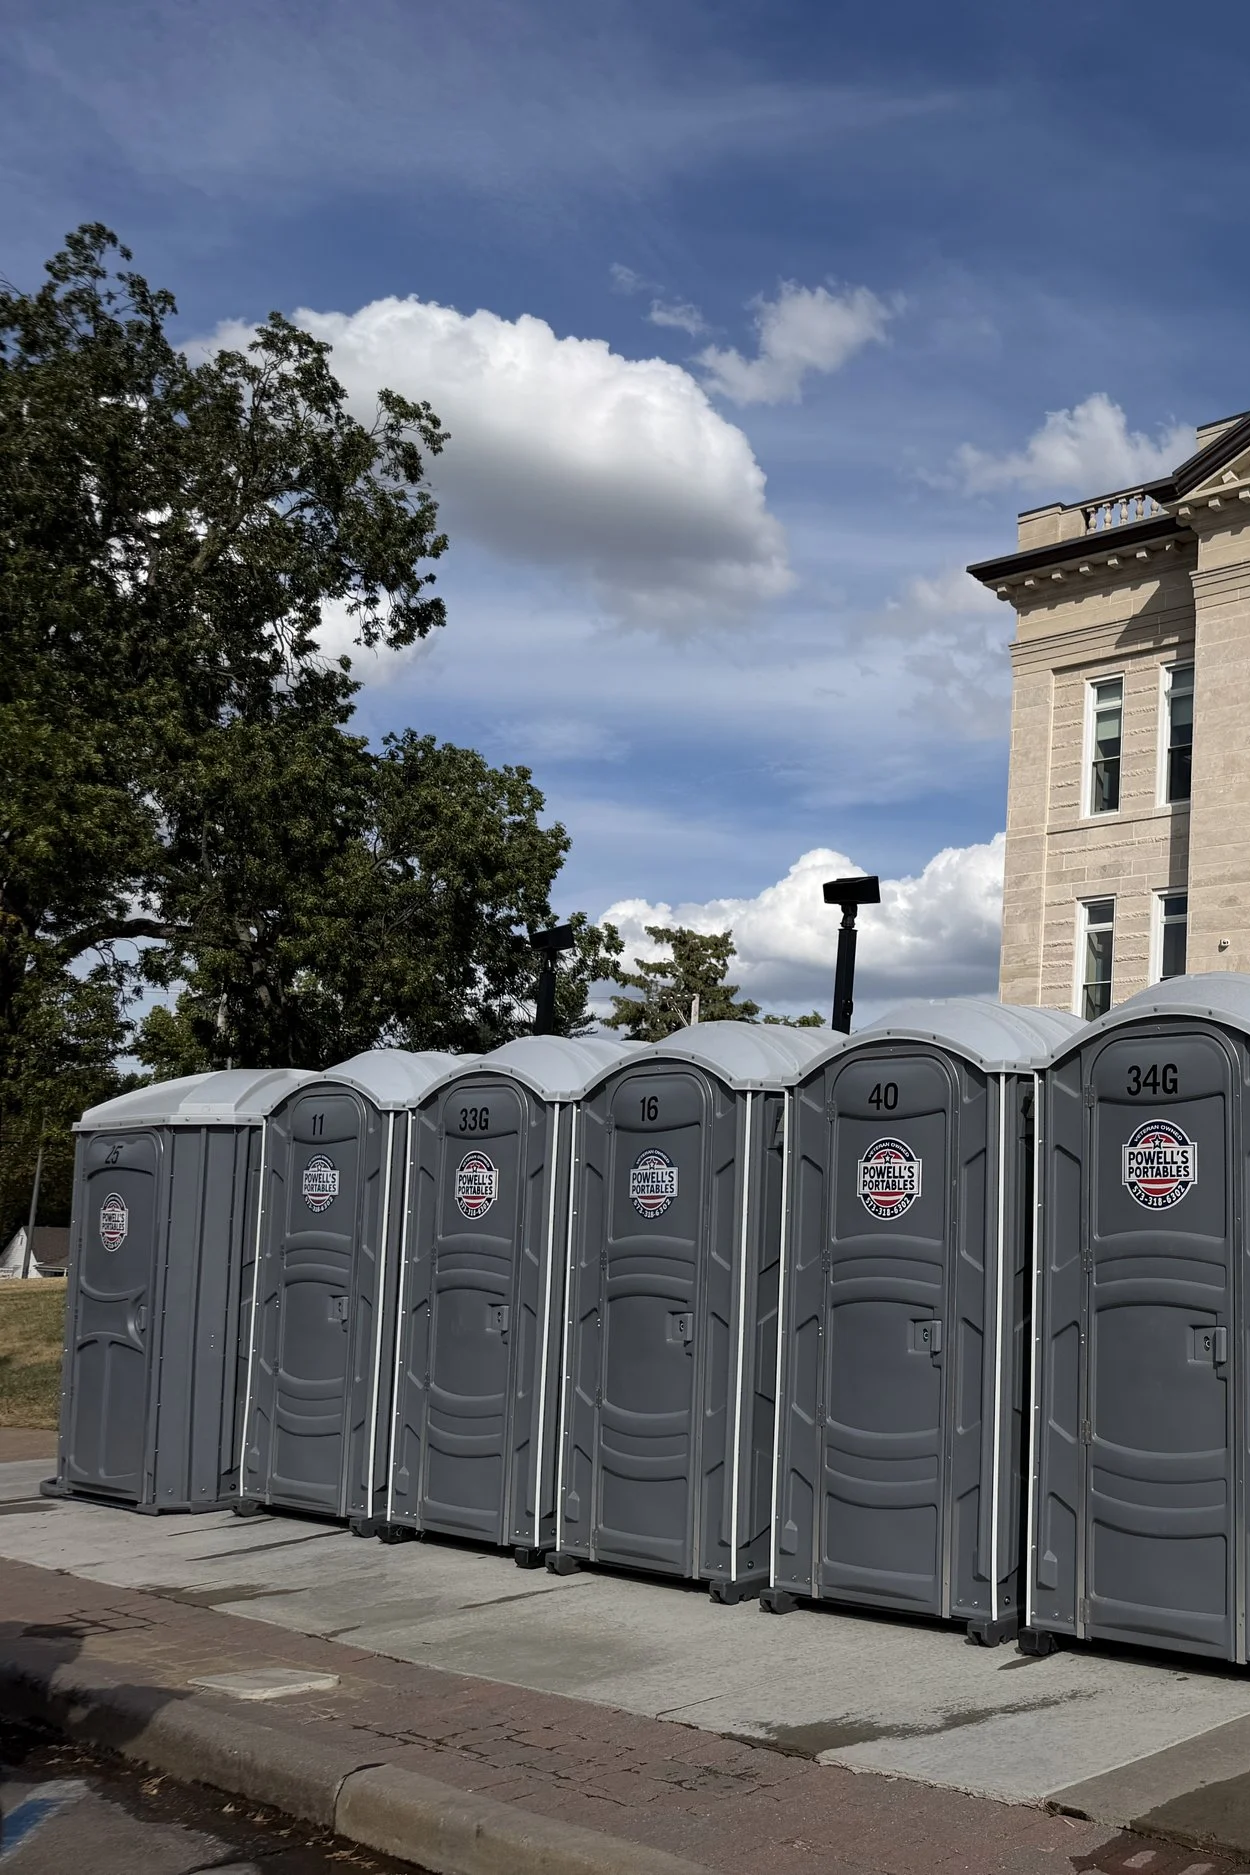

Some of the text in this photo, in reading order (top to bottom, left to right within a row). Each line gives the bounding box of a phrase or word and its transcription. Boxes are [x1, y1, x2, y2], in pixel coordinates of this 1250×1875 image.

[1126, 1063, 1178, 1096] 34G
[868, 1082, 899, 1111] 40
[640, 1095, 659, 1122] 16
[312, 1113, 324, 1136] 11
[459, 1107, 490, 1132] 33G
[1133, 1124, 1184, 1142] VETERAN OWNED
[105, 1145, 124, 1165] 25
[868, 1141, 910, 1158] VETERAN OWNED
[1128, 1150, 1189, 1166] POWELL'S
[304, 1173, 337, 1184] POWELL'S
[458, 1174, 493, 1186] POWELL'S
[632, 1170, 675, 1184] POWELL'S
[862, 1165, 915, 1179] POWELL'S
[1128, 1166, 1190, 1179] PORTABLES
[304, 1184, 337, 1193] PORTABLES
[458, 1185, 493, 1195] PORTABLES
[631, 1183, 675, 1195] PORTABLES
[862, 1179, 915, 1191] PORTABLES
[1131, 1184, 1186, 1207] 573-318-6302
[865, 1197, 911, 1217] 573-318-6302
